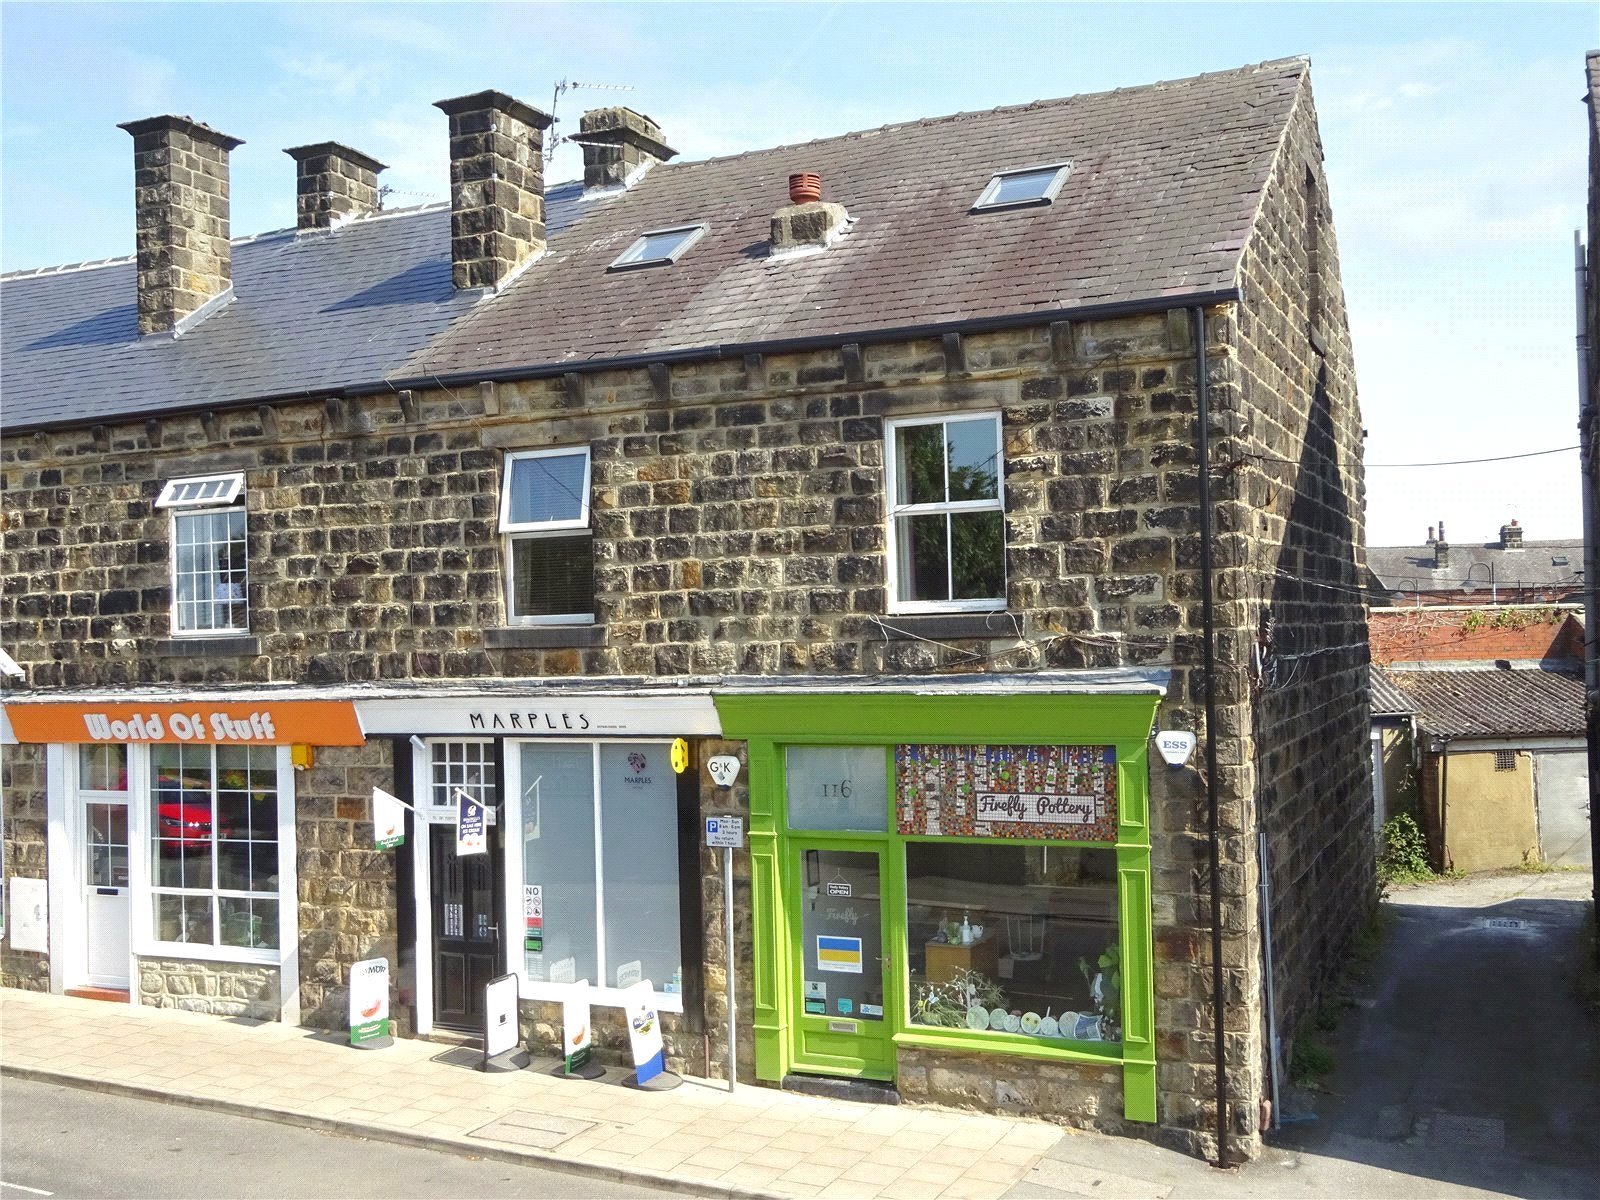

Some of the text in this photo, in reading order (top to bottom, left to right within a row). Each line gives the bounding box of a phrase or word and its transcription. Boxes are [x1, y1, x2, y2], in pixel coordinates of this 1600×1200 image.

[83, 711, 276, 740] World Of Stuff
[469, 713, 590, 730] MARPLES
[1163, 740, 1188, 749] ESS
[624, 776, 652, 784] MARPLES
[821, 779, 853, 798] 116
[979, 795, 1092, 823] Firefly Pottery
[525, 887, 539, 896] NO
